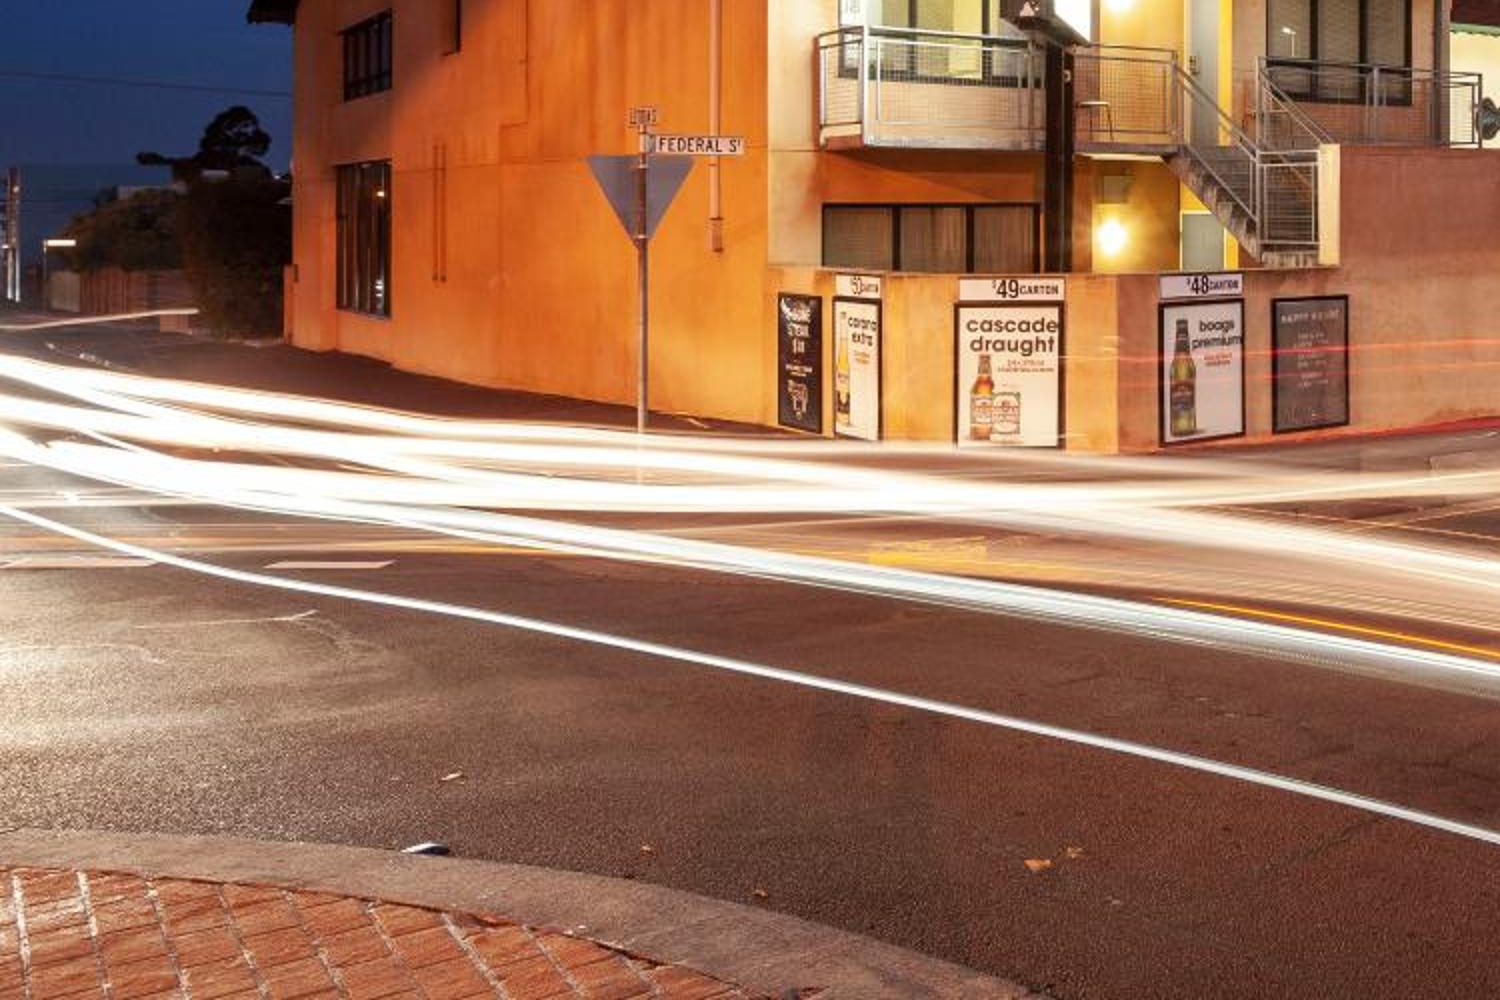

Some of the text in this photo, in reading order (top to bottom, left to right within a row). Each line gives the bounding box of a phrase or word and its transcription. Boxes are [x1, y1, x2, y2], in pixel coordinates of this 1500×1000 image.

[659, 137, 722, 153] FEDERAL
[1020, 285, 1059, 295] CARTON
[966, 316, 1058, 333] cascade
[969, 336, 1055, 357] draught
[1191, 335, 1242, 351] premium
